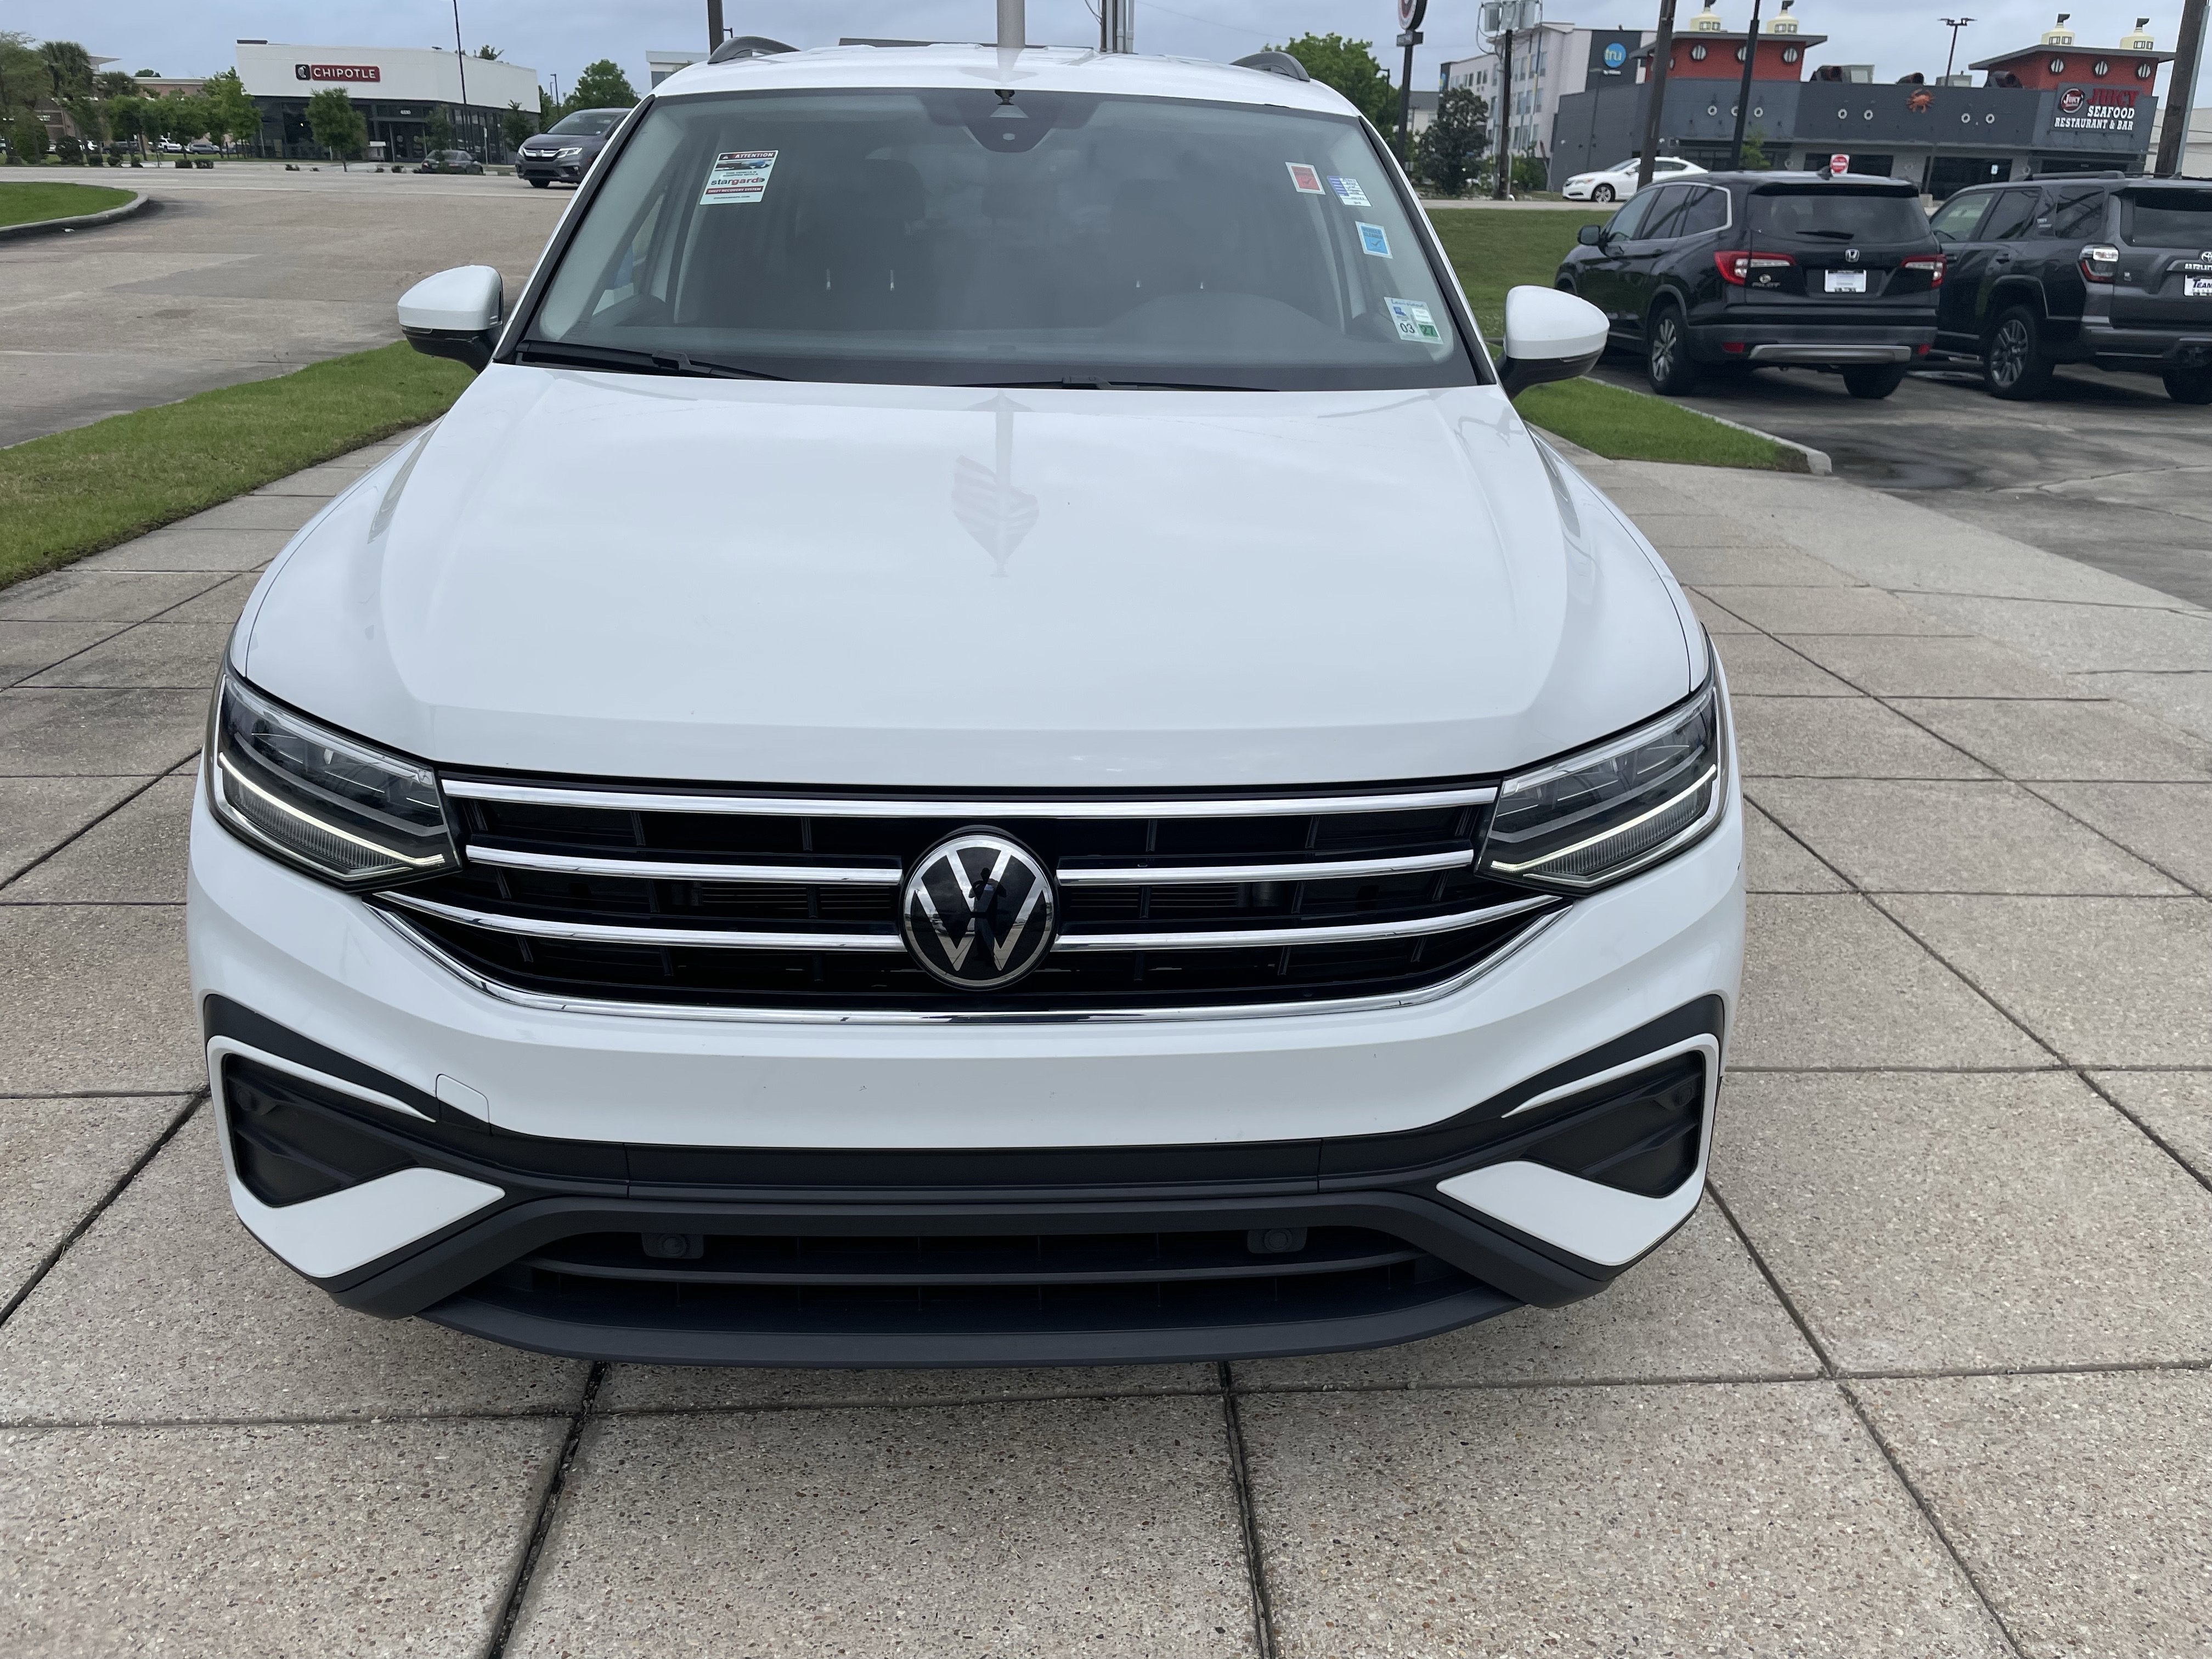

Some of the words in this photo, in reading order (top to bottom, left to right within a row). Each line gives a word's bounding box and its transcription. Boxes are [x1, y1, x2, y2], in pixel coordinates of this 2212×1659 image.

[313, 67, 376, 78] CHIPOTLE
[2086, 88, 2140, 108] JUICY
[2087, 105, 2135, 119] SEAFOOD
[2054, 117, 2108, 129] RESTAURANT
[2109, 120, 2115, 130] &
[2117, 120, 2134, 131] BAR
[711, 177, 759, 185] stargard
[1400, 323, 1415, 334] 03
[1420, 325, 1434, 336] 27
